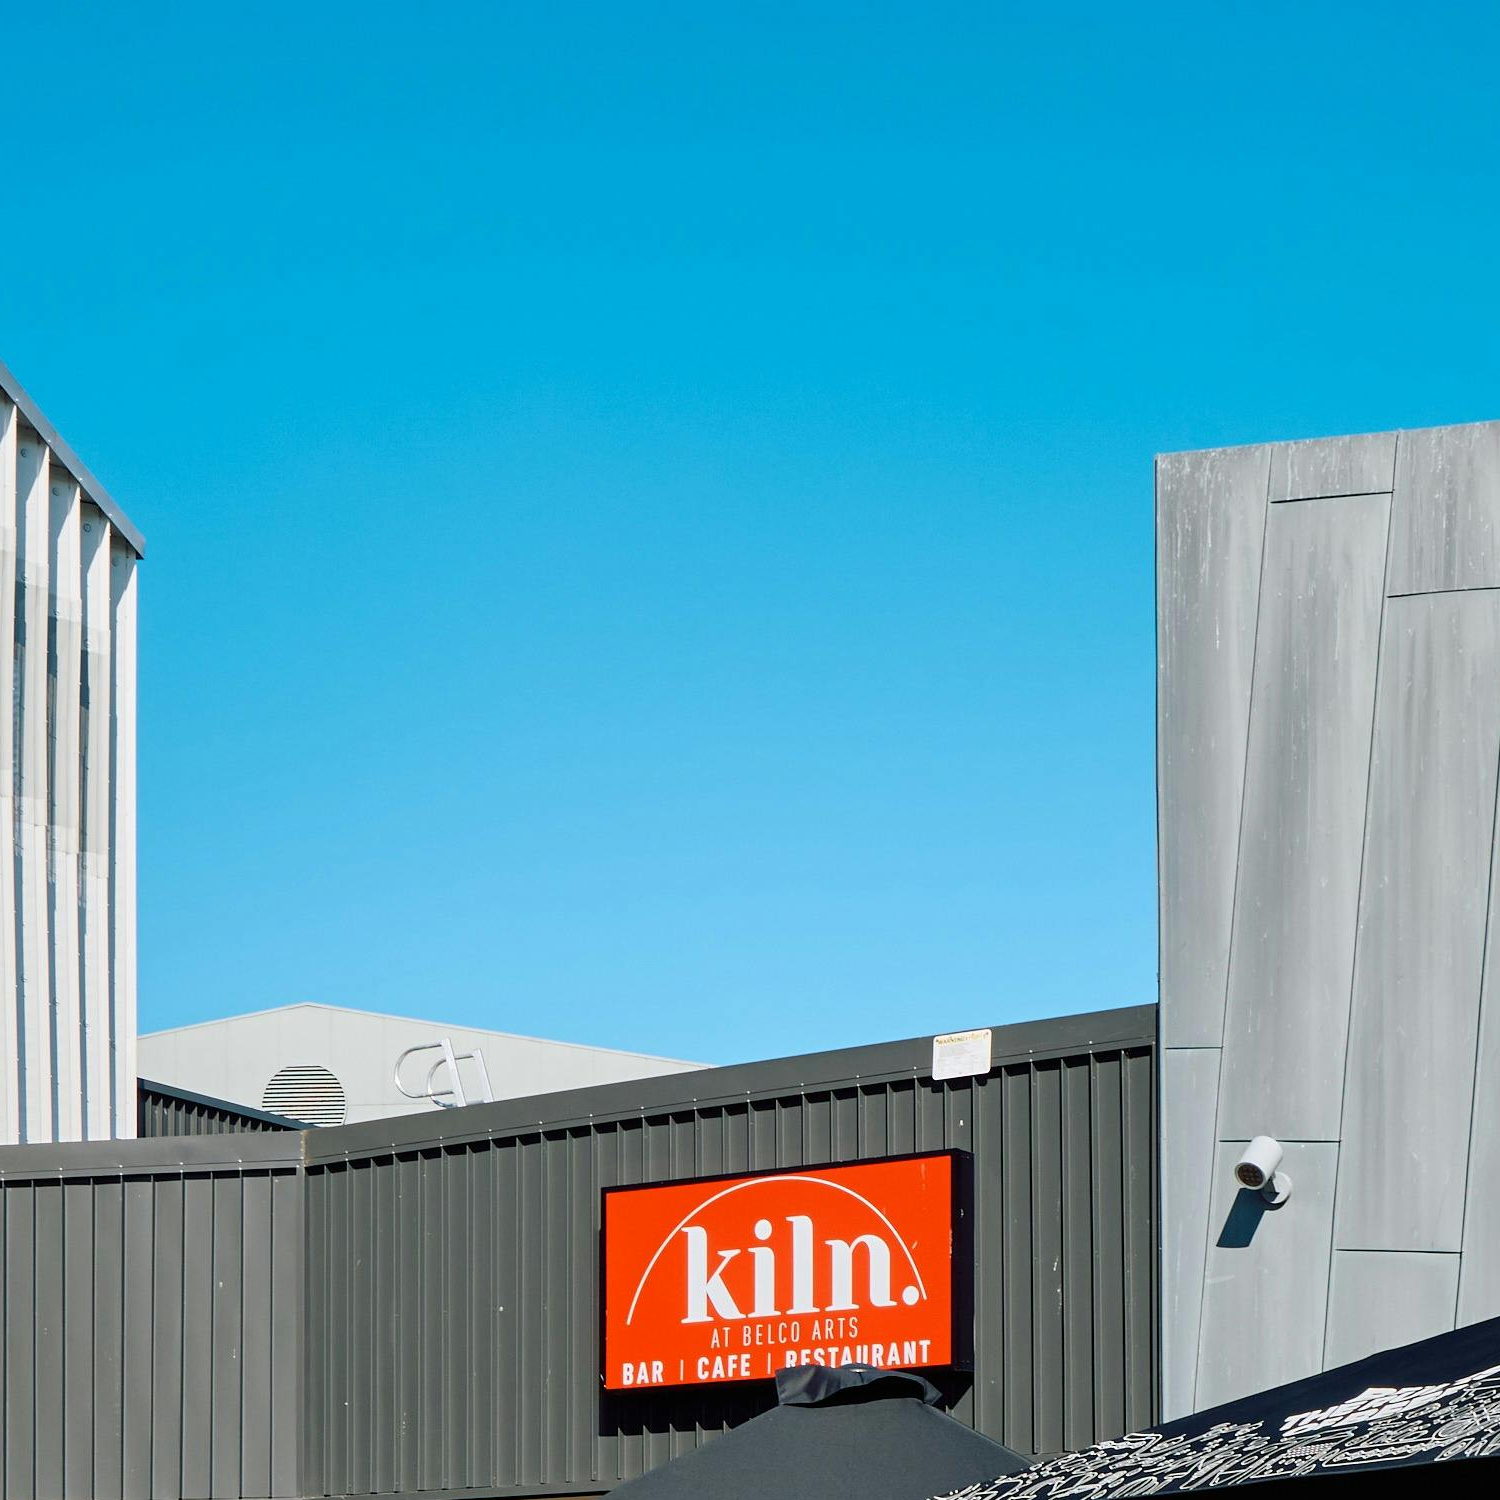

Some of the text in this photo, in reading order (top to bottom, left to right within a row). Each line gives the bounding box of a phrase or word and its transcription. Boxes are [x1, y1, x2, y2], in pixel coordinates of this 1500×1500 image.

[681, 1215, 920, 1325] kiln.
[711, 1317, 860, 1349] AT BELCO ARTS
[622, 1359, 664, 1386] BAR
[697, 1353, 751, 1380] CAFE
